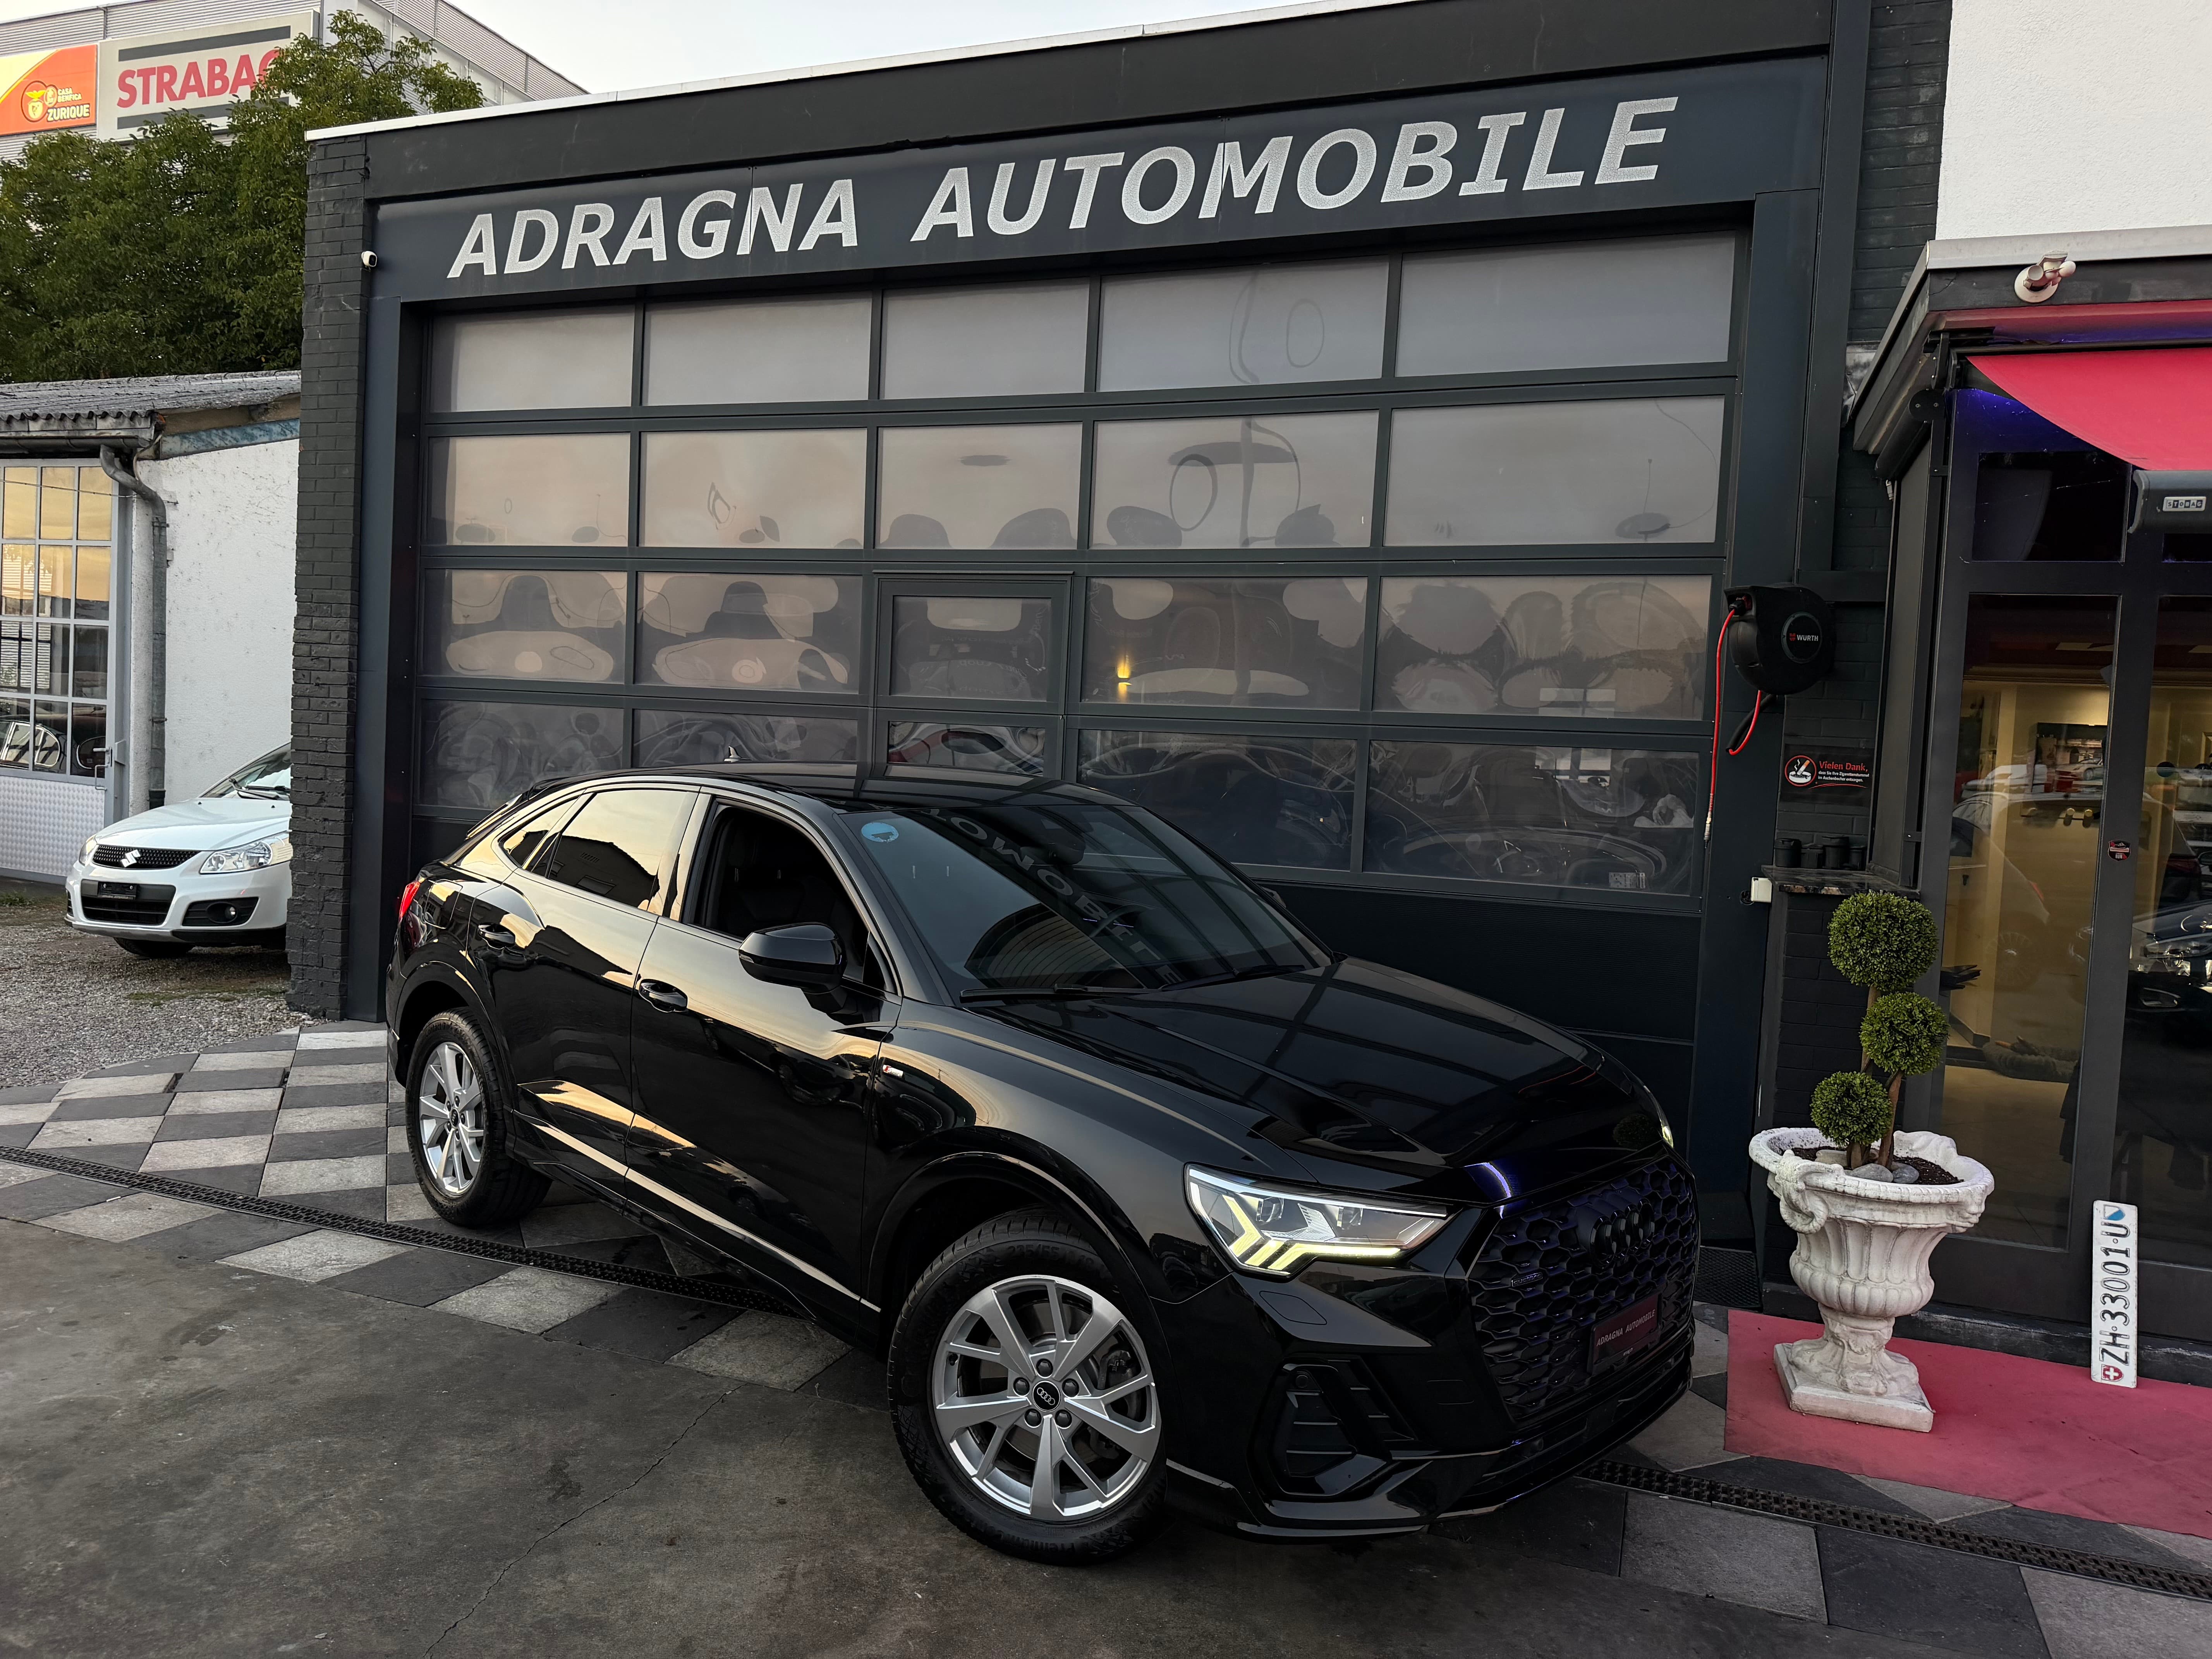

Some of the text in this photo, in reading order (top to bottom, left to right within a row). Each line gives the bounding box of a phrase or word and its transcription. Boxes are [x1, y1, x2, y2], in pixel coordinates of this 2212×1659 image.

[57, 87, 73, 95] CASA
[57, 93, 82, 103] BENFICA
[47, 104, 90, 122] ZURIQUE
[446, 96, 1679, 278] ADRAGNA AUTOMOBILE
[1819, 760, 1869, 773] Vielen Dank,
[1596, 1309, 1656, 1347] ADRAGNA AUTOMOBILE
